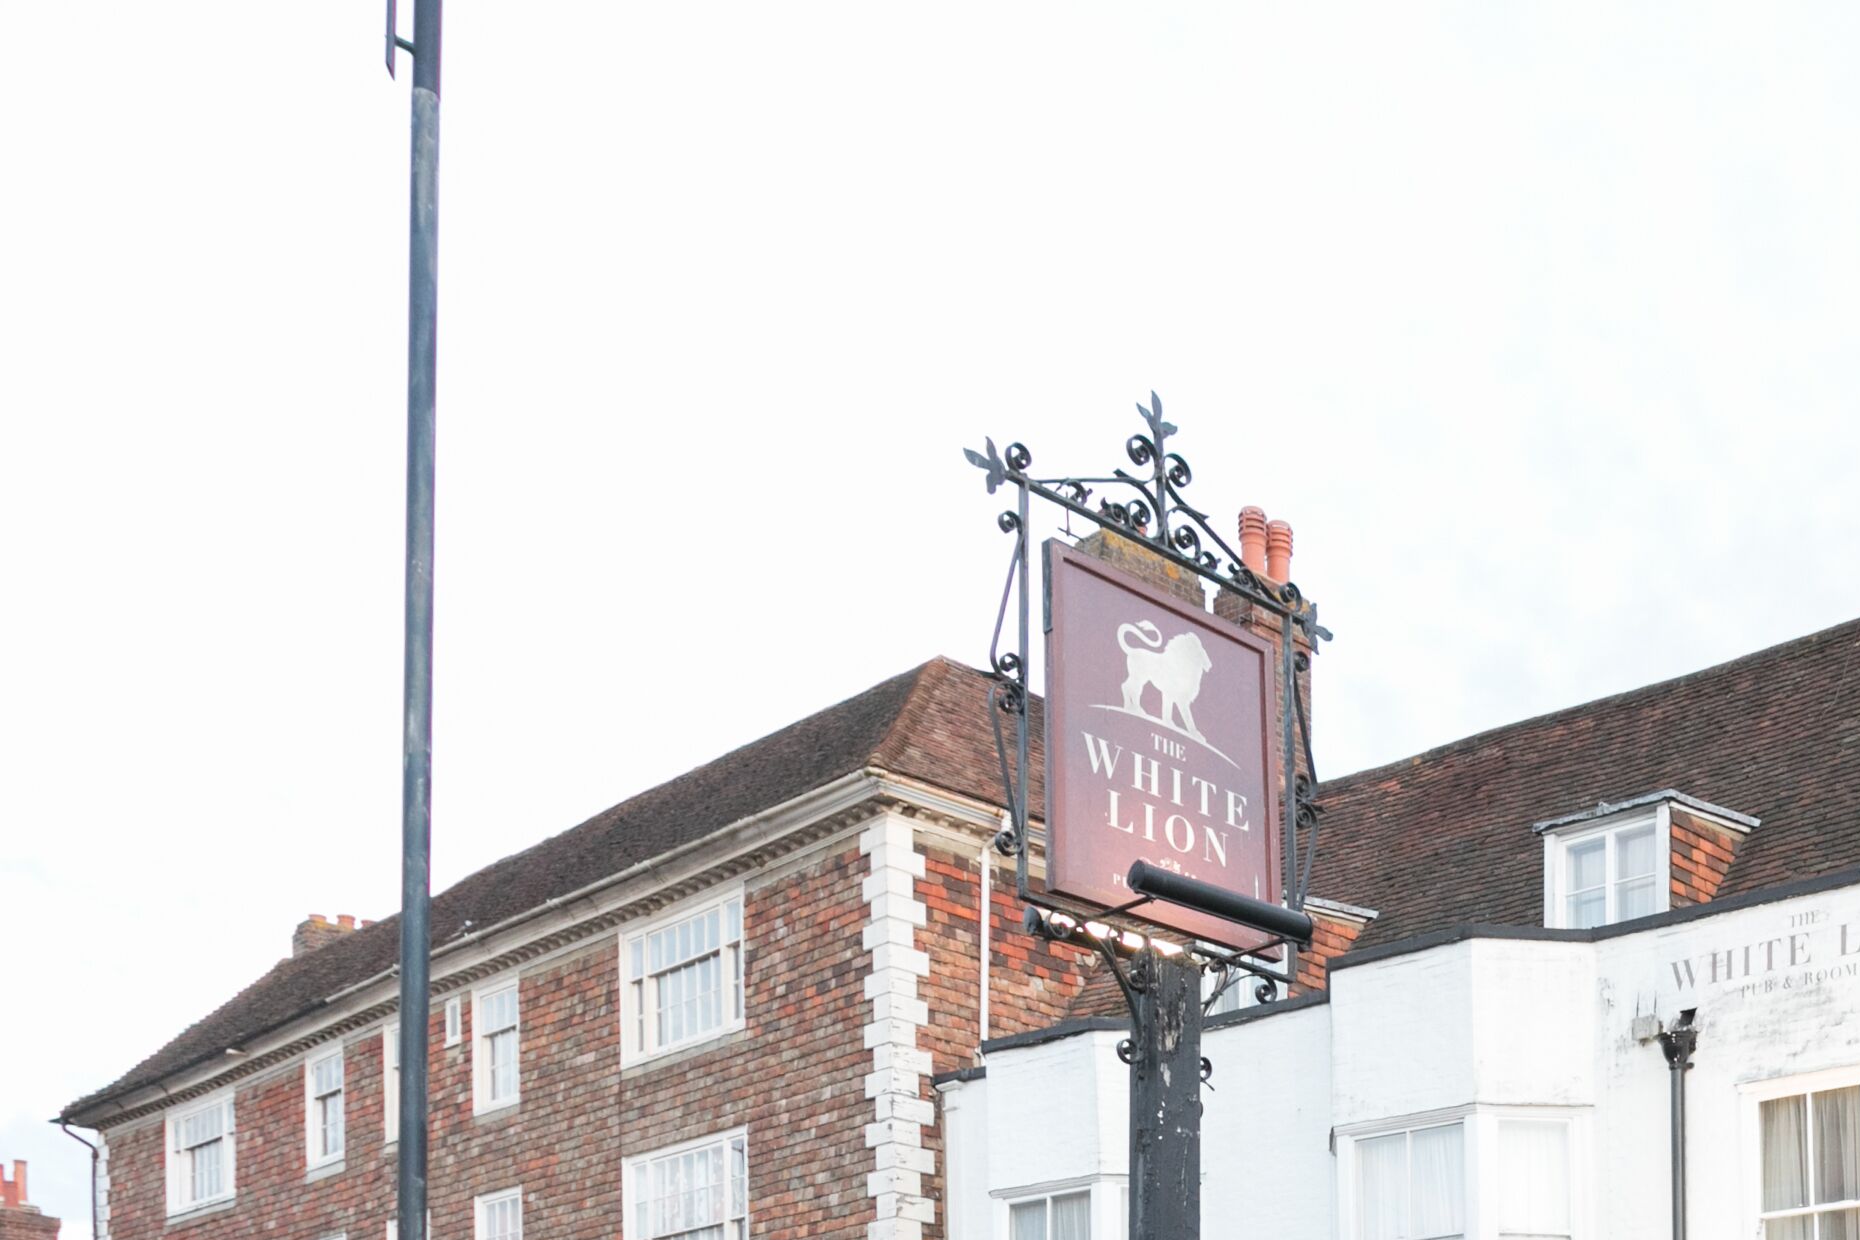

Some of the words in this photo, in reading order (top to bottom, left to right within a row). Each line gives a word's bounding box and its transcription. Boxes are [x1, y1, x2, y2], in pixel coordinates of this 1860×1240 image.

[1151, 733, 1186, 761] THE
[1081, 731, 1249, 832] WHITE
[1107, 788, 1229, 868] LION
[1790, 909, 1820, 929] THE
[1670, 931, 1812, 992] WHITE
[1740, 979, 1775, 999] PUB
[1783, 978, 1793, 989] &
